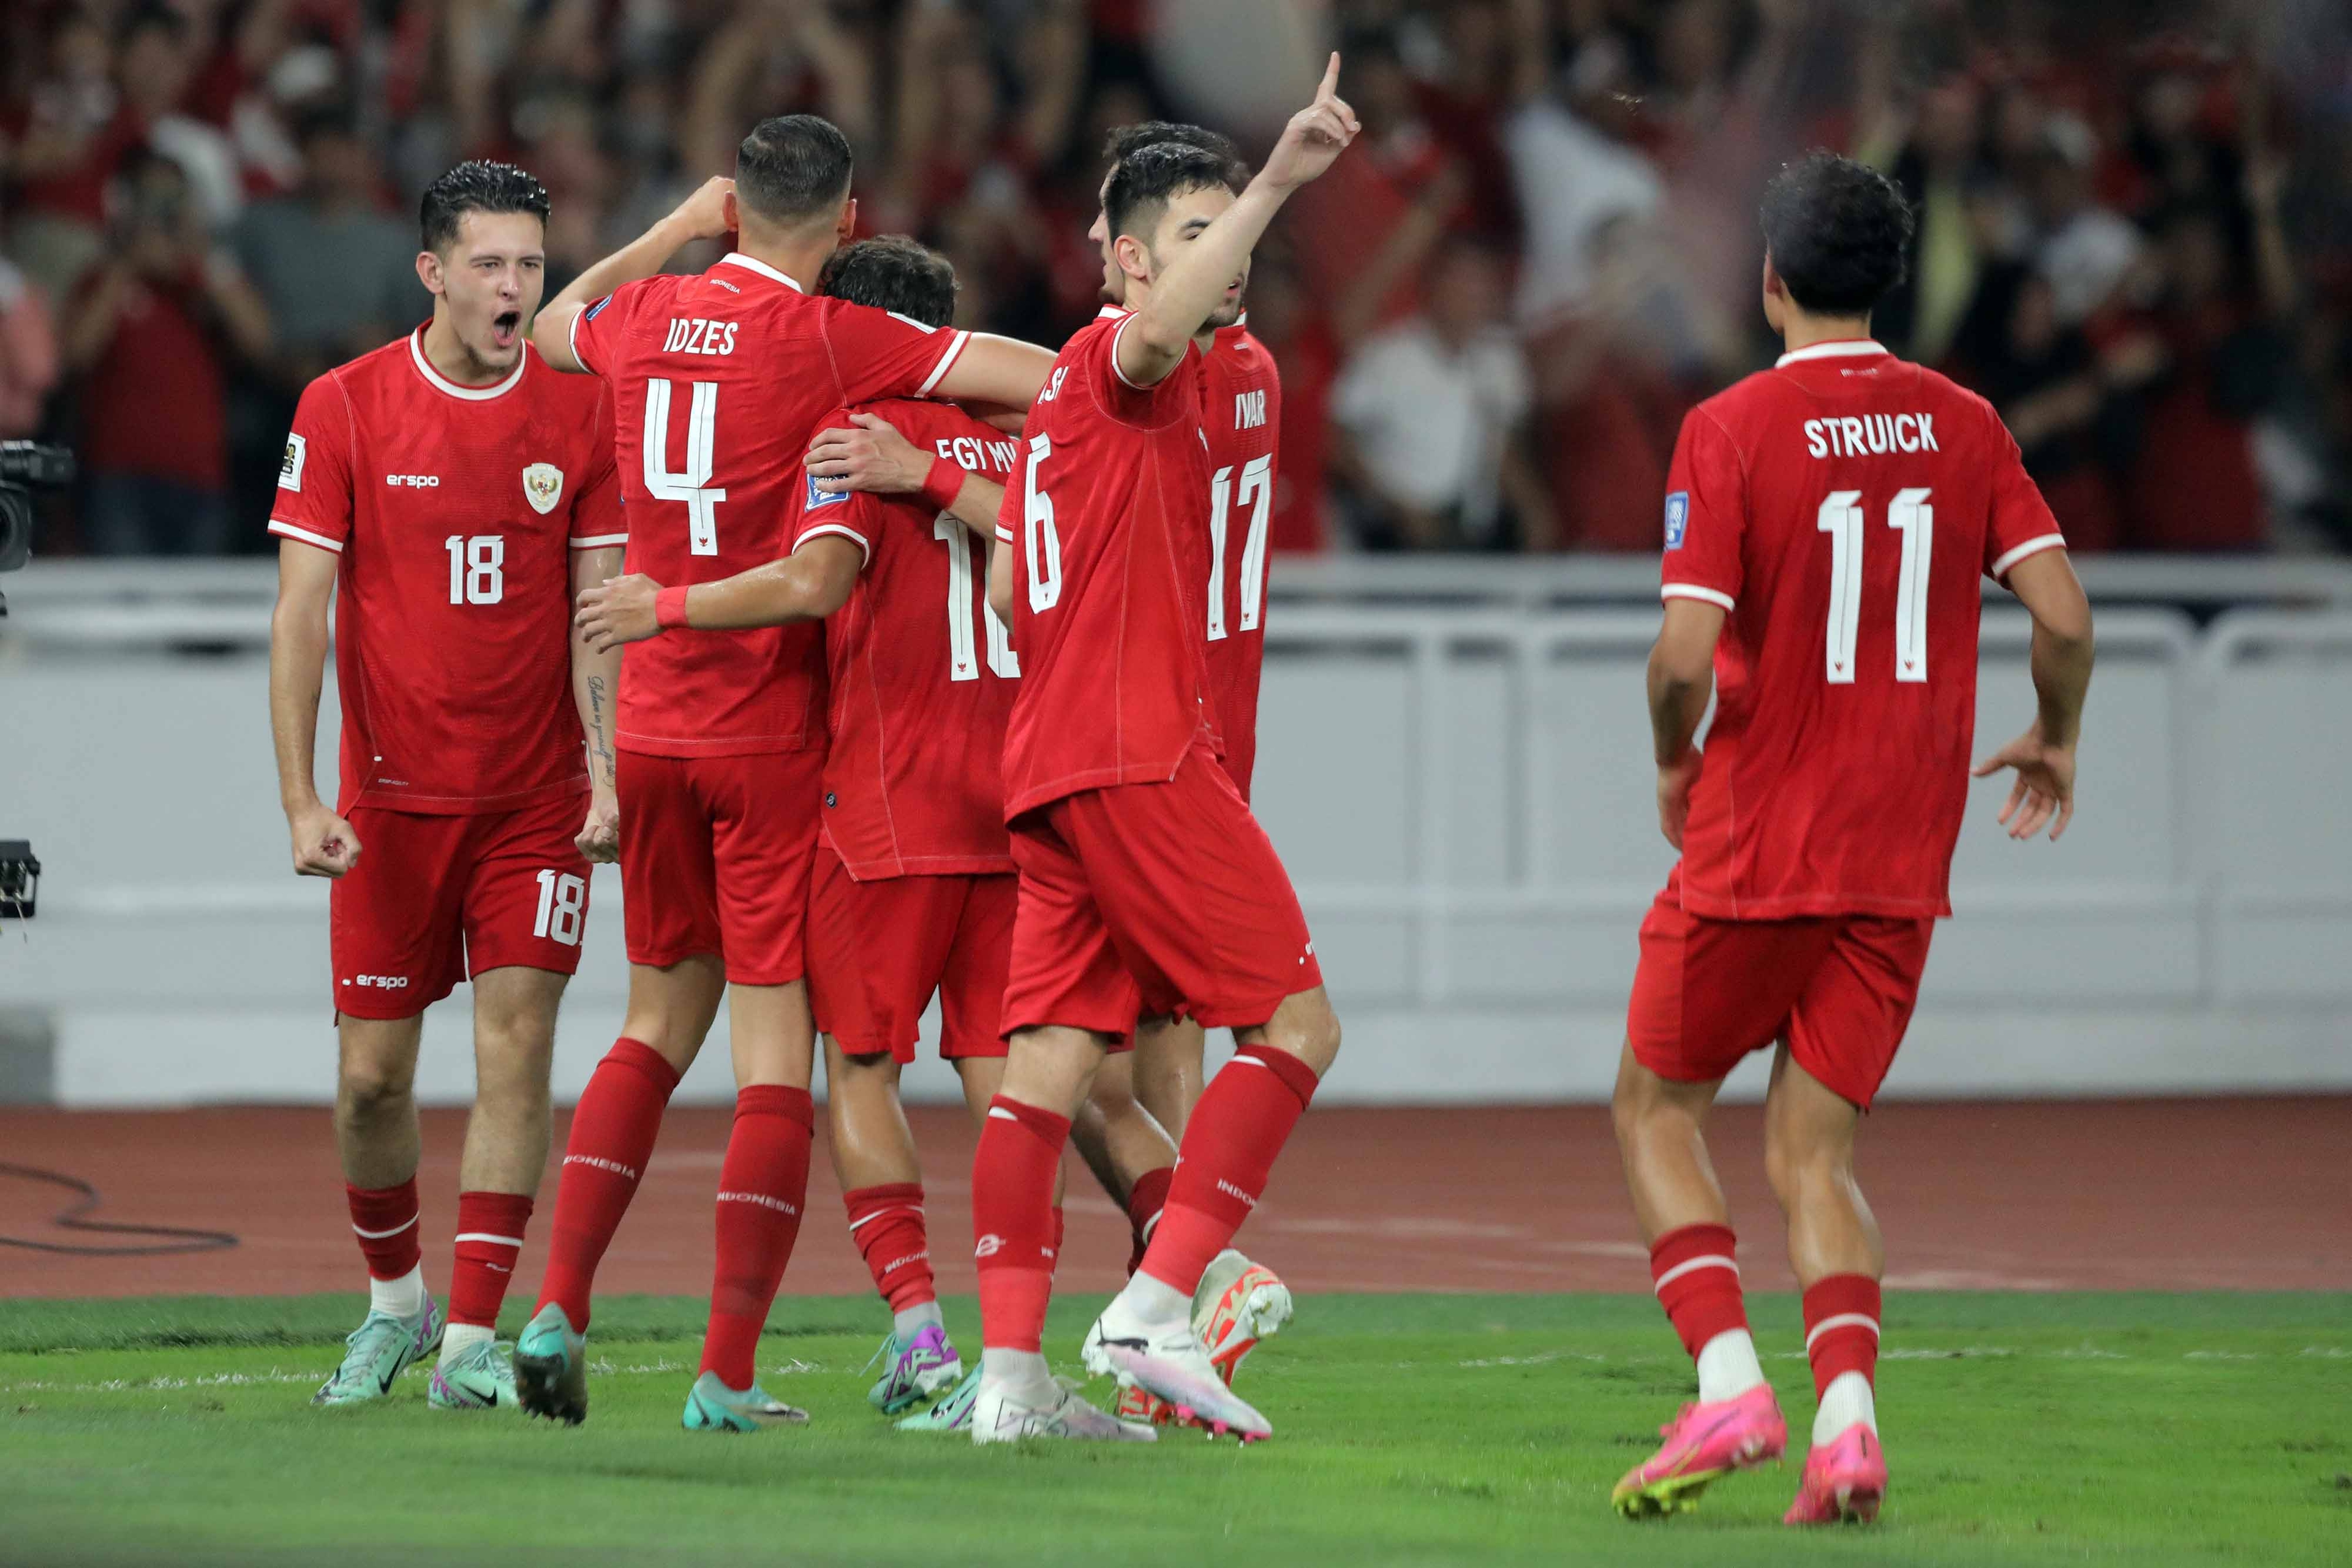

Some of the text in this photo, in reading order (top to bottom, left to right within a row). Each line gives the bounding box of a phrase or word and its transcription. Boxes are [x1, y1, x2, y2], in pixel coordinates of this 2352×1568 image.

[662, 318, 739, 356] IDZES
[1235, 389, 1266, 430] IVAR
[1804, 412, 1939, 459] STRUICK
[386, 474, 439, 489] erspo
[643, 378, 726, 556] 4
[935, 437, 987, 471] EGY
[1024, 431, 1063, 615] 6
[1207, 452, 1272, 642] 17
[445, 535, 504, 605] 18
[1817, 488, 1934, 684] 11
[533, 869, 585, 947] 18
[356, 974, 408, 990] erspo
